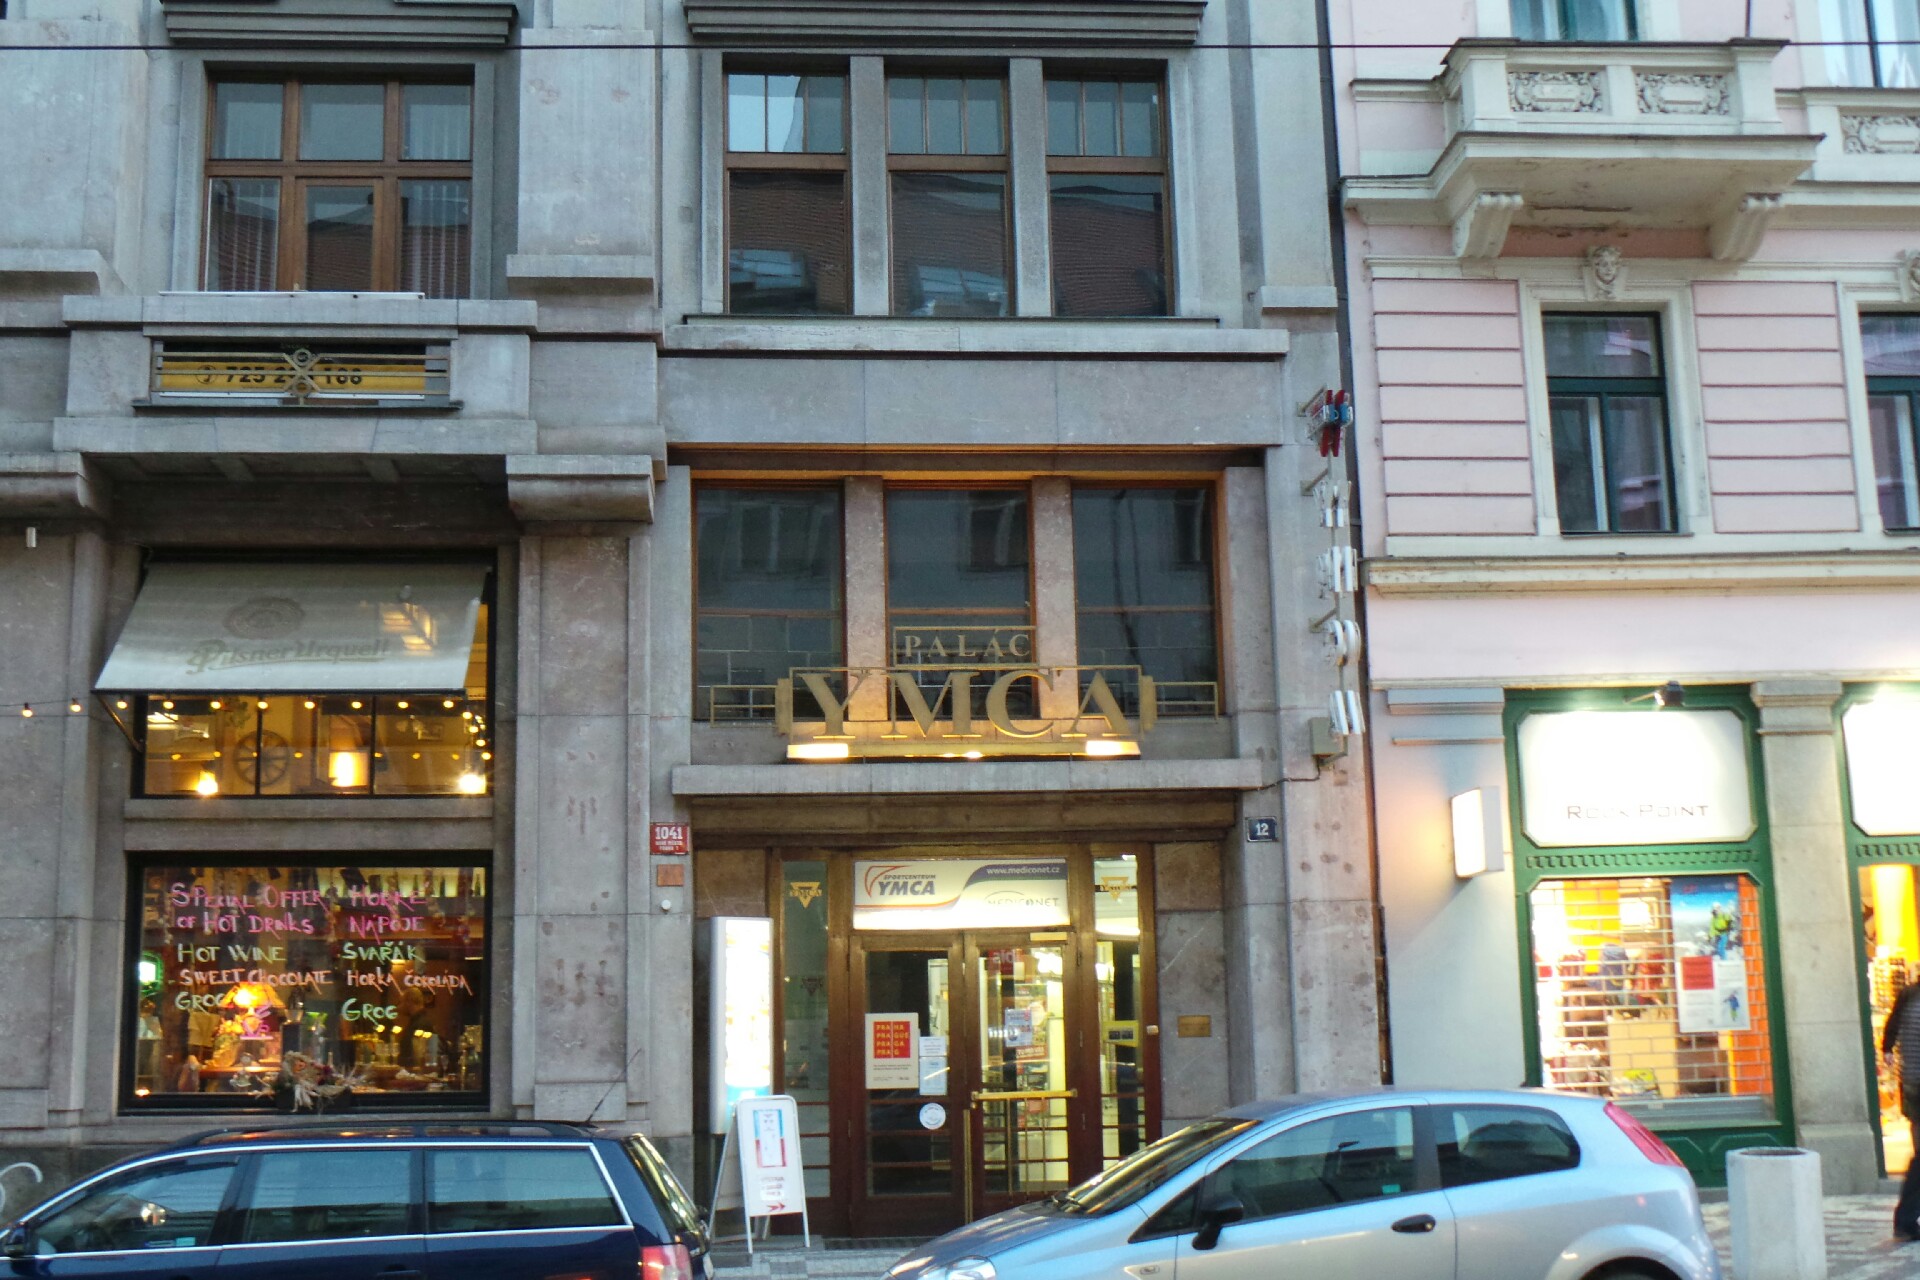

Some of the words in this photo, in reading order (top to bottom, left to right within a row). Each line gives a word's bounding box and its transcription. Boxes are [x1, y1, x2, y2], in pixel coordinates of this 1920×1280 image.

[904, 628, 1030, 657] PALÁC
[186, 639, 289, 675] Pilsner
[294, 638, 389, 664] Urquell
[798, 669, 1131, 738] YMCA
[1567, 805, 1630, 820] ROK
[1639, 804, 1709, 817] POINT
[655, 826, 683, 840] 1041
[1255, 822, 1269, 836] 12
[986, 866, 1060, 875] www.mediconet.cz
[878, 880, 936, 896] YMCA
[203, 911, 241, 934] HOT
[177, 943, 221, 963] HOT
[228, 944, 287, 964] WINE
[342, 941, 426, 965] SVAŘÁK
[179, 968, 246, 986] SWEET
